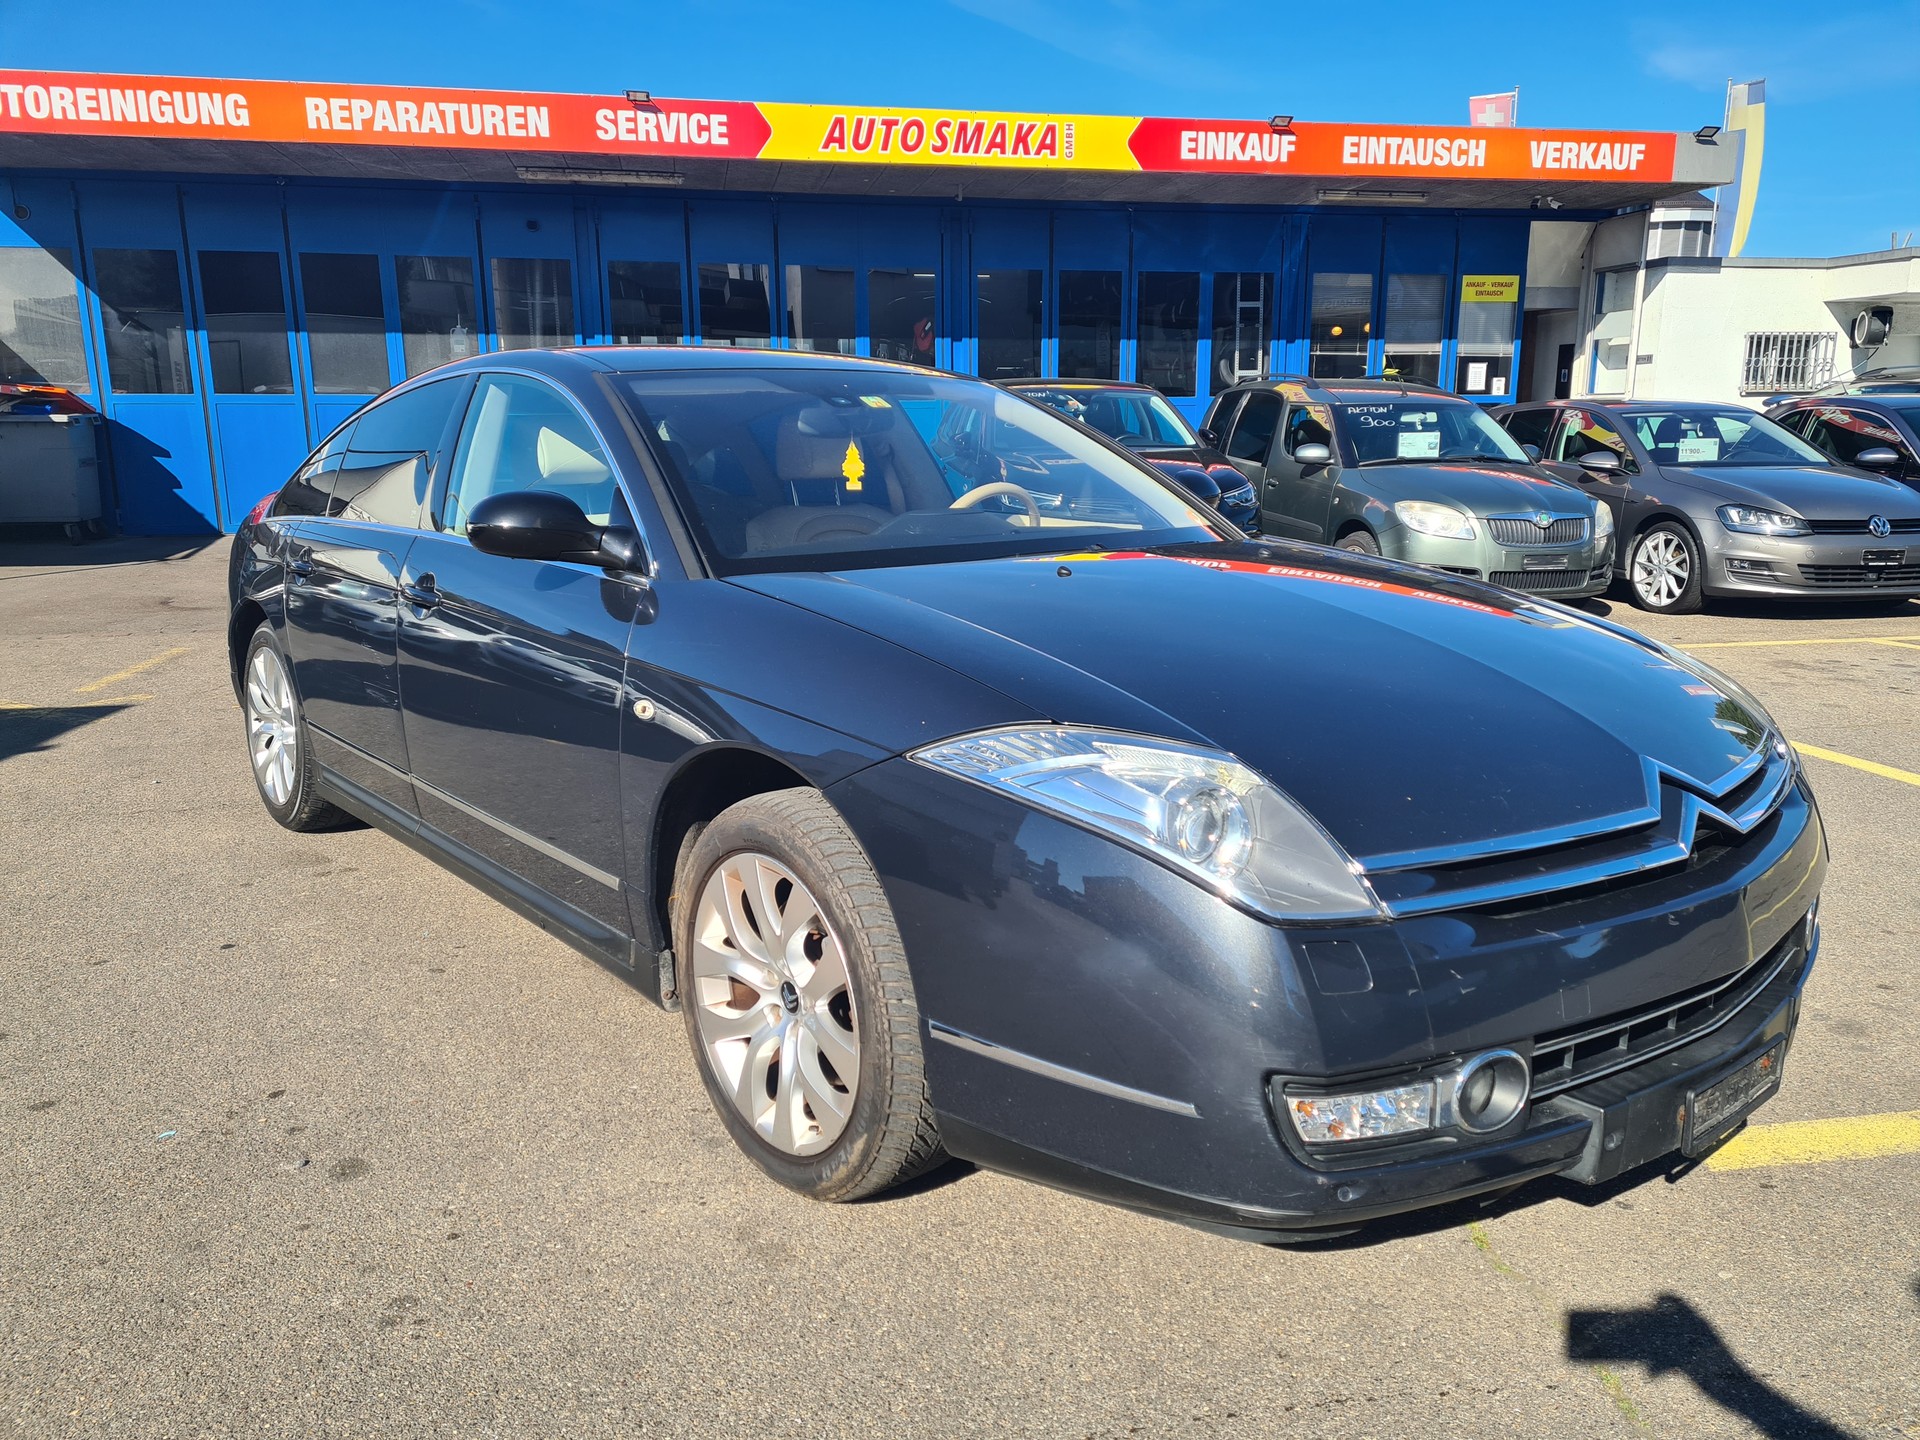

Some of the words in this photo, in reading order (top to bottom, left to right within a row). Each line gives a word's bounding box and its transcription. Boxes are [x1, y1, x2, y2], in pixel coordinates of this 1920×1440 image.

[0, 84, 249, 126] TOREINIGUNG
[306, 98, 550, 138] REPARATUREN
[596, 109, 728, 145] SERVICE
[820, 116, 926, 153] AUTO
[930, 119, 1058, 157] SMAKA
[1065, 123, 1074, 159] GMBH
[1181, 131, 1296, 162] EINKAUF
[1343, 136, 1486, 166] EINTAUSCH
[1531, 141, 1645, 170] VERKAUF
